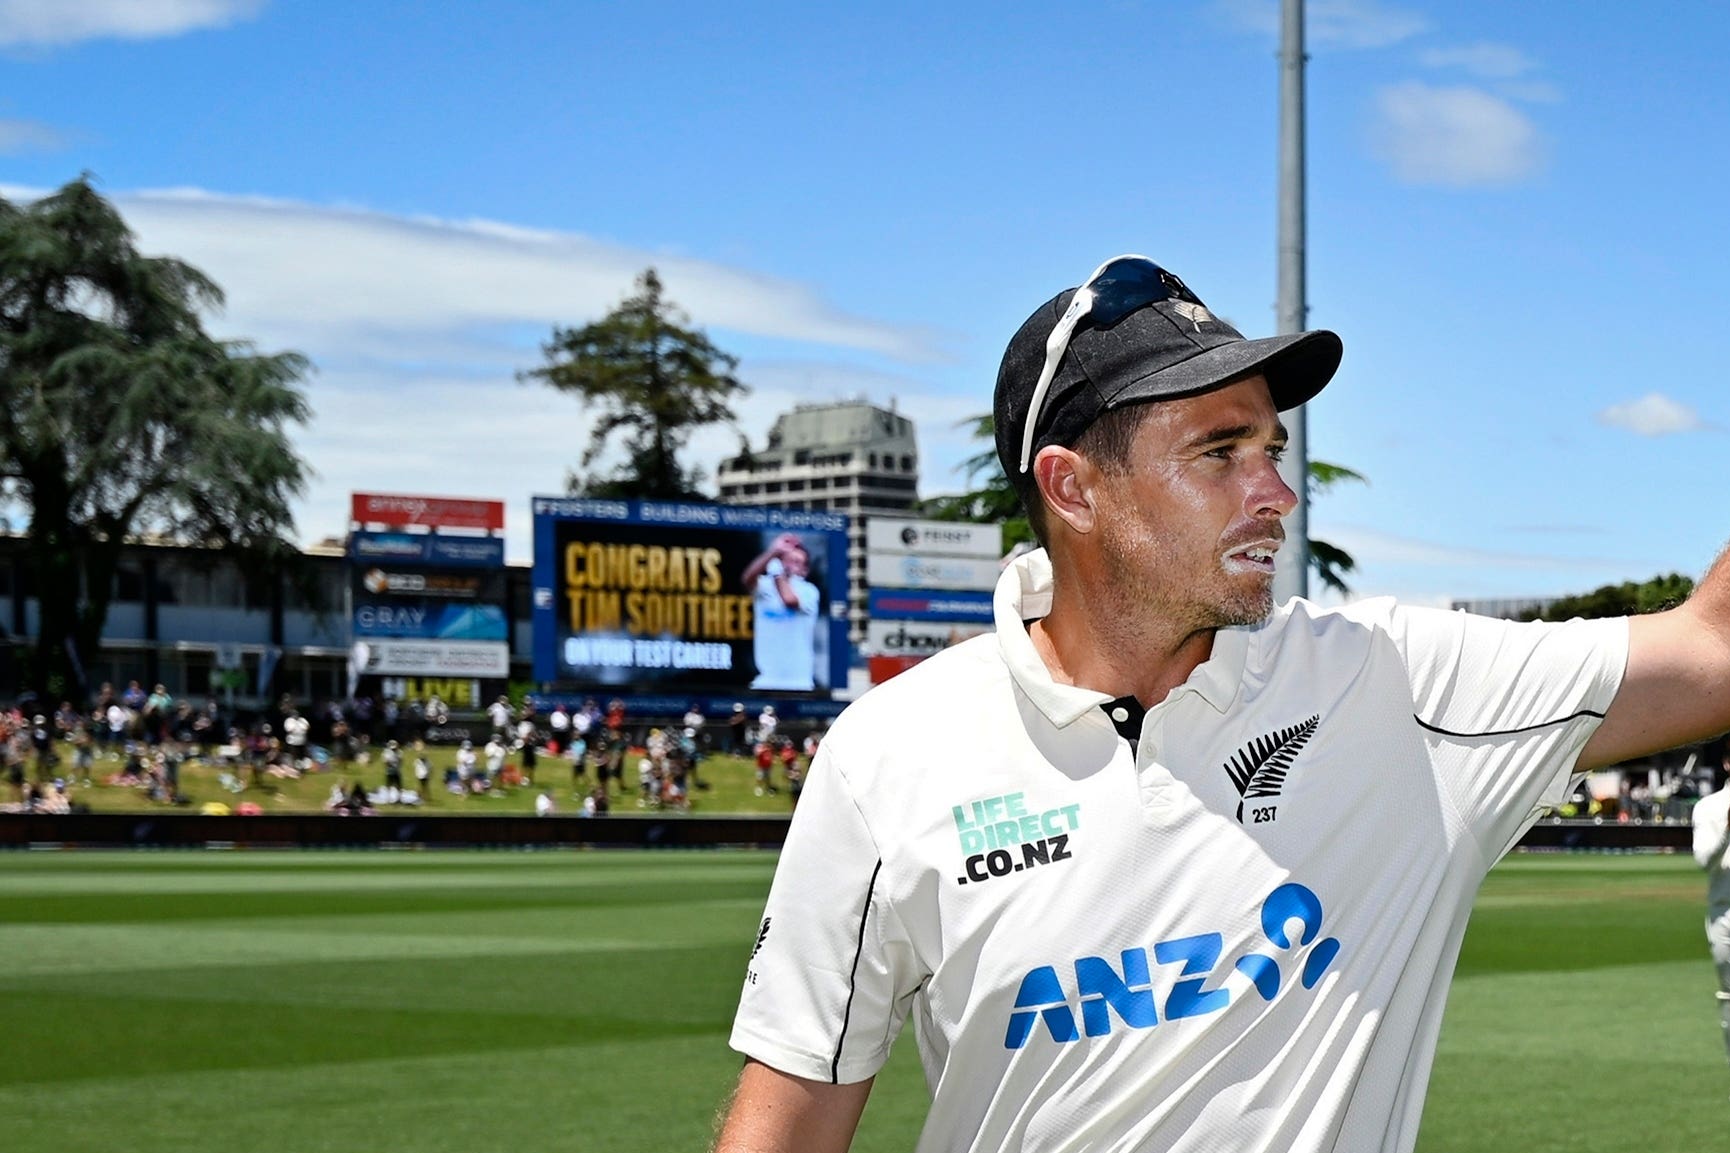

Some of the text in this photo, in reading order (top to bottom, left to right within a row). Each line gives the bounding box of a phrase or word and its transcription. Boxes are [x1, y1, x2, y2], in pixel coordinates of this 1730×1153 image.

[550, 501, 628, 519] FOSTERS
[640, 502, 720, 525] BUILDING
[769, 510, 844, 531] PURPOSE
[566, 541, 722, 593] CONGRATS
[357, 605, 425, 629] GRAY
[566, 588, 755, 640] TIM SOUTHEE
[634, 639, 671, 668] TEST
[672, 641, 732, 670] CAREER
[952, 792, 1027, 832] LIFE
[959, 803, 1080, 856] DIRECT
[1252, 806, 1277, 823] 237
[957, 834, 1072, 885] .CO.NZ
[1004, 932, 1230, 1049] ANZ
